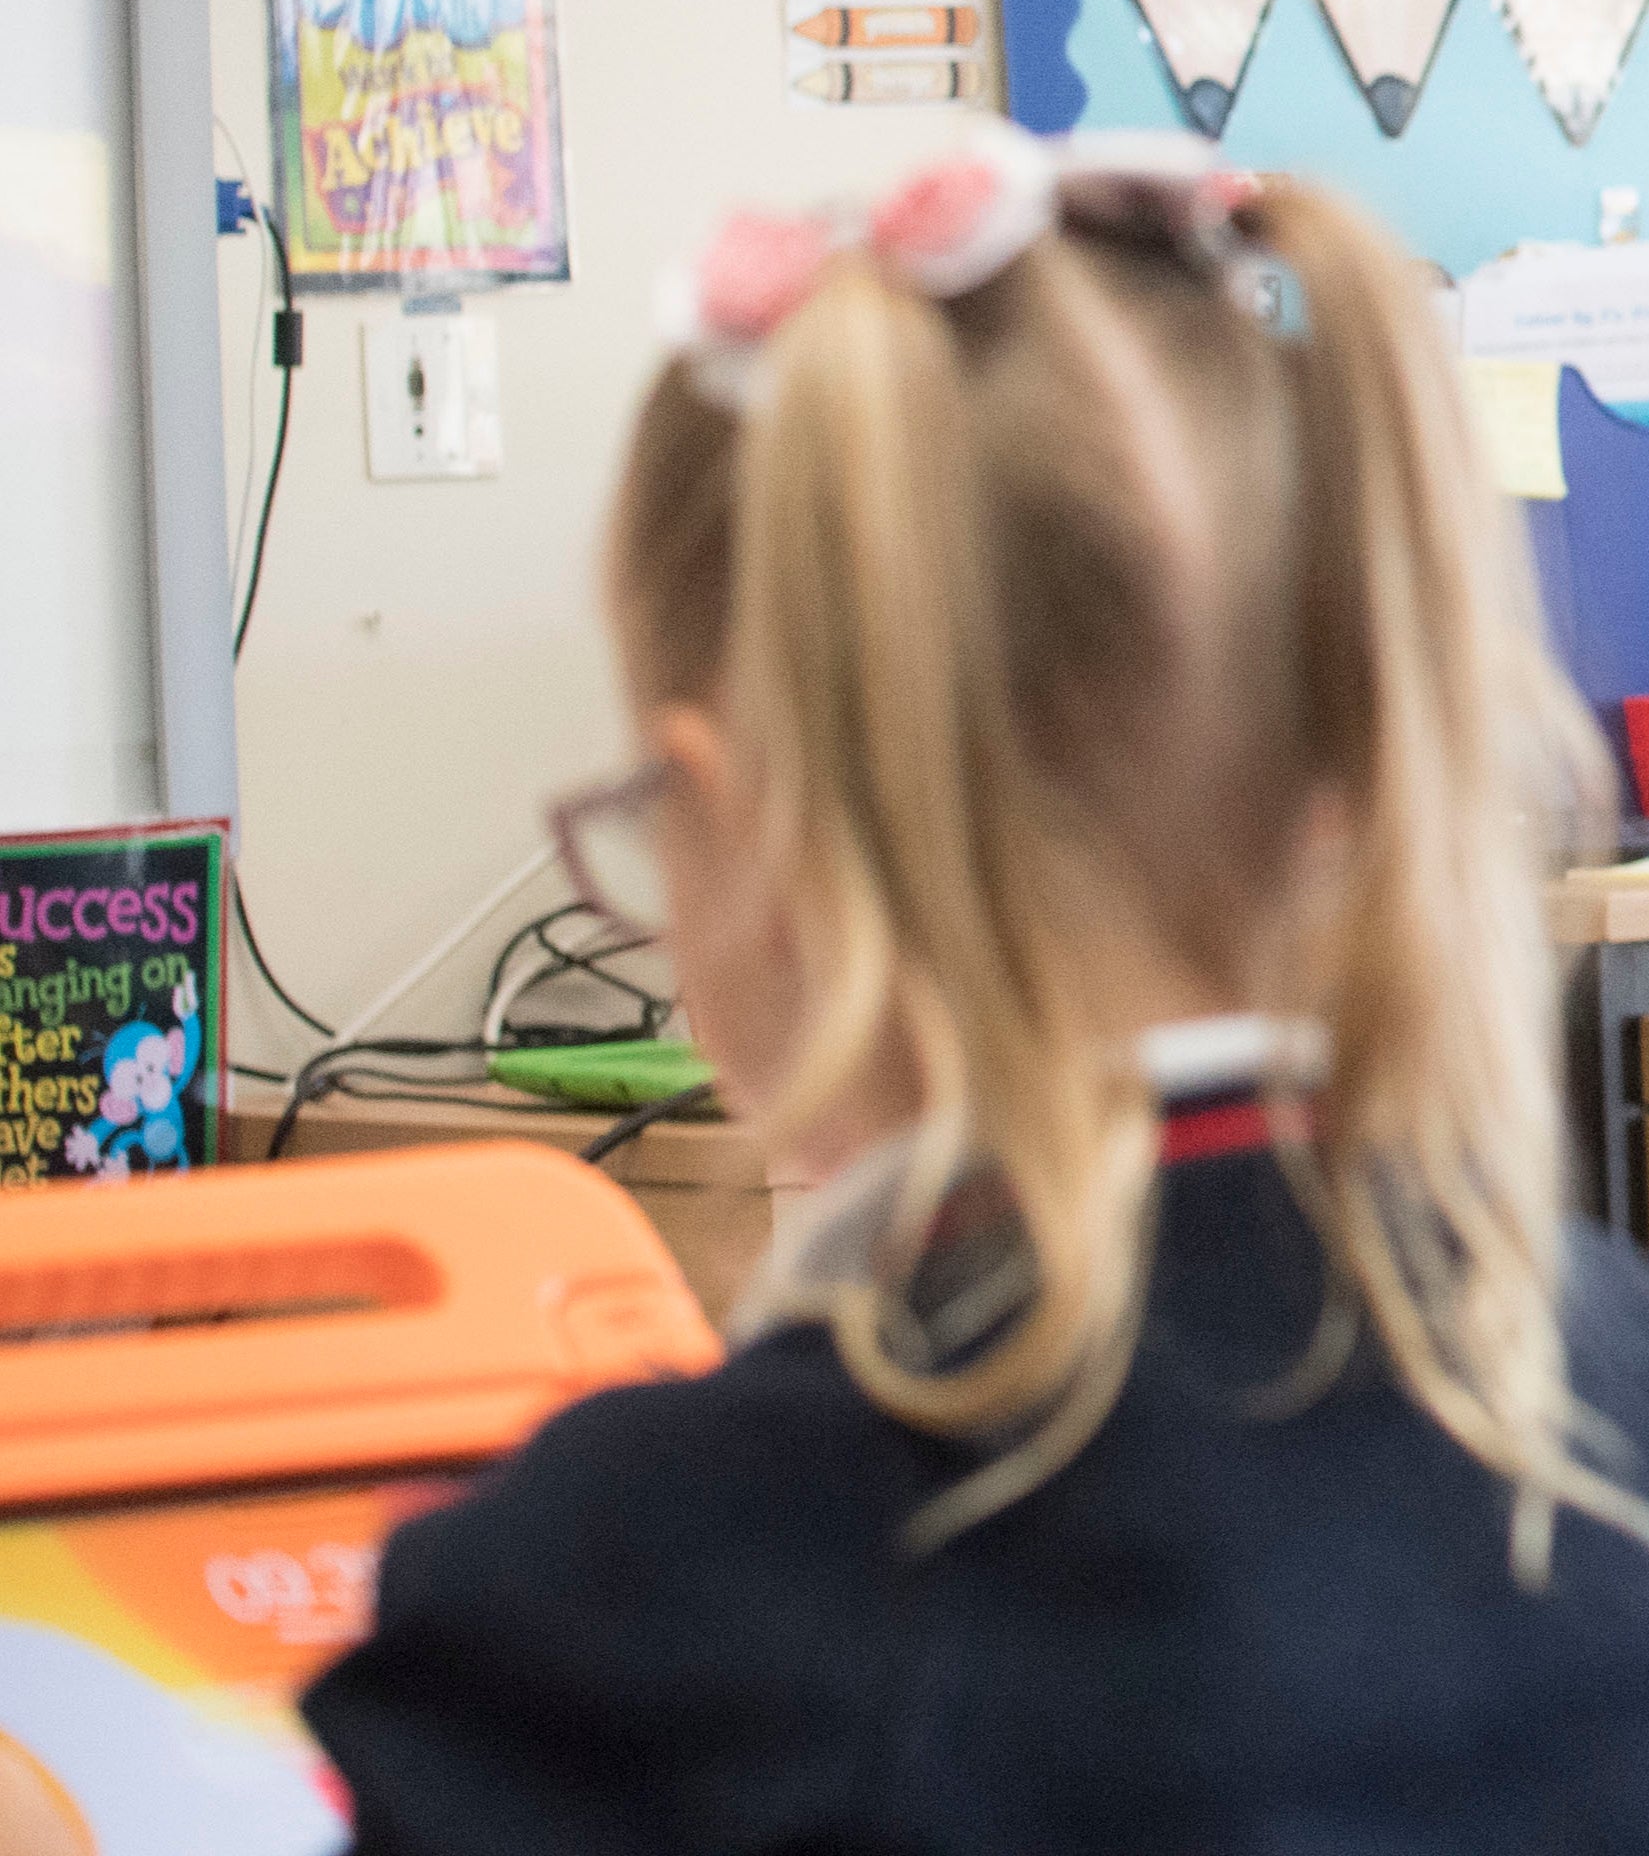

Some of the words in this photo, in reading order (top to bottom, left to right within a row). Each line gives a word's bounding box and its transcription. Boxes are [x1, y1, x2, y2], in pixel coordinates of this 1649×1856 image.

[0, 880, 199, 945] uccess
[141, 951, 191, 996] on
[0, 1111, 63, 1157] ave
